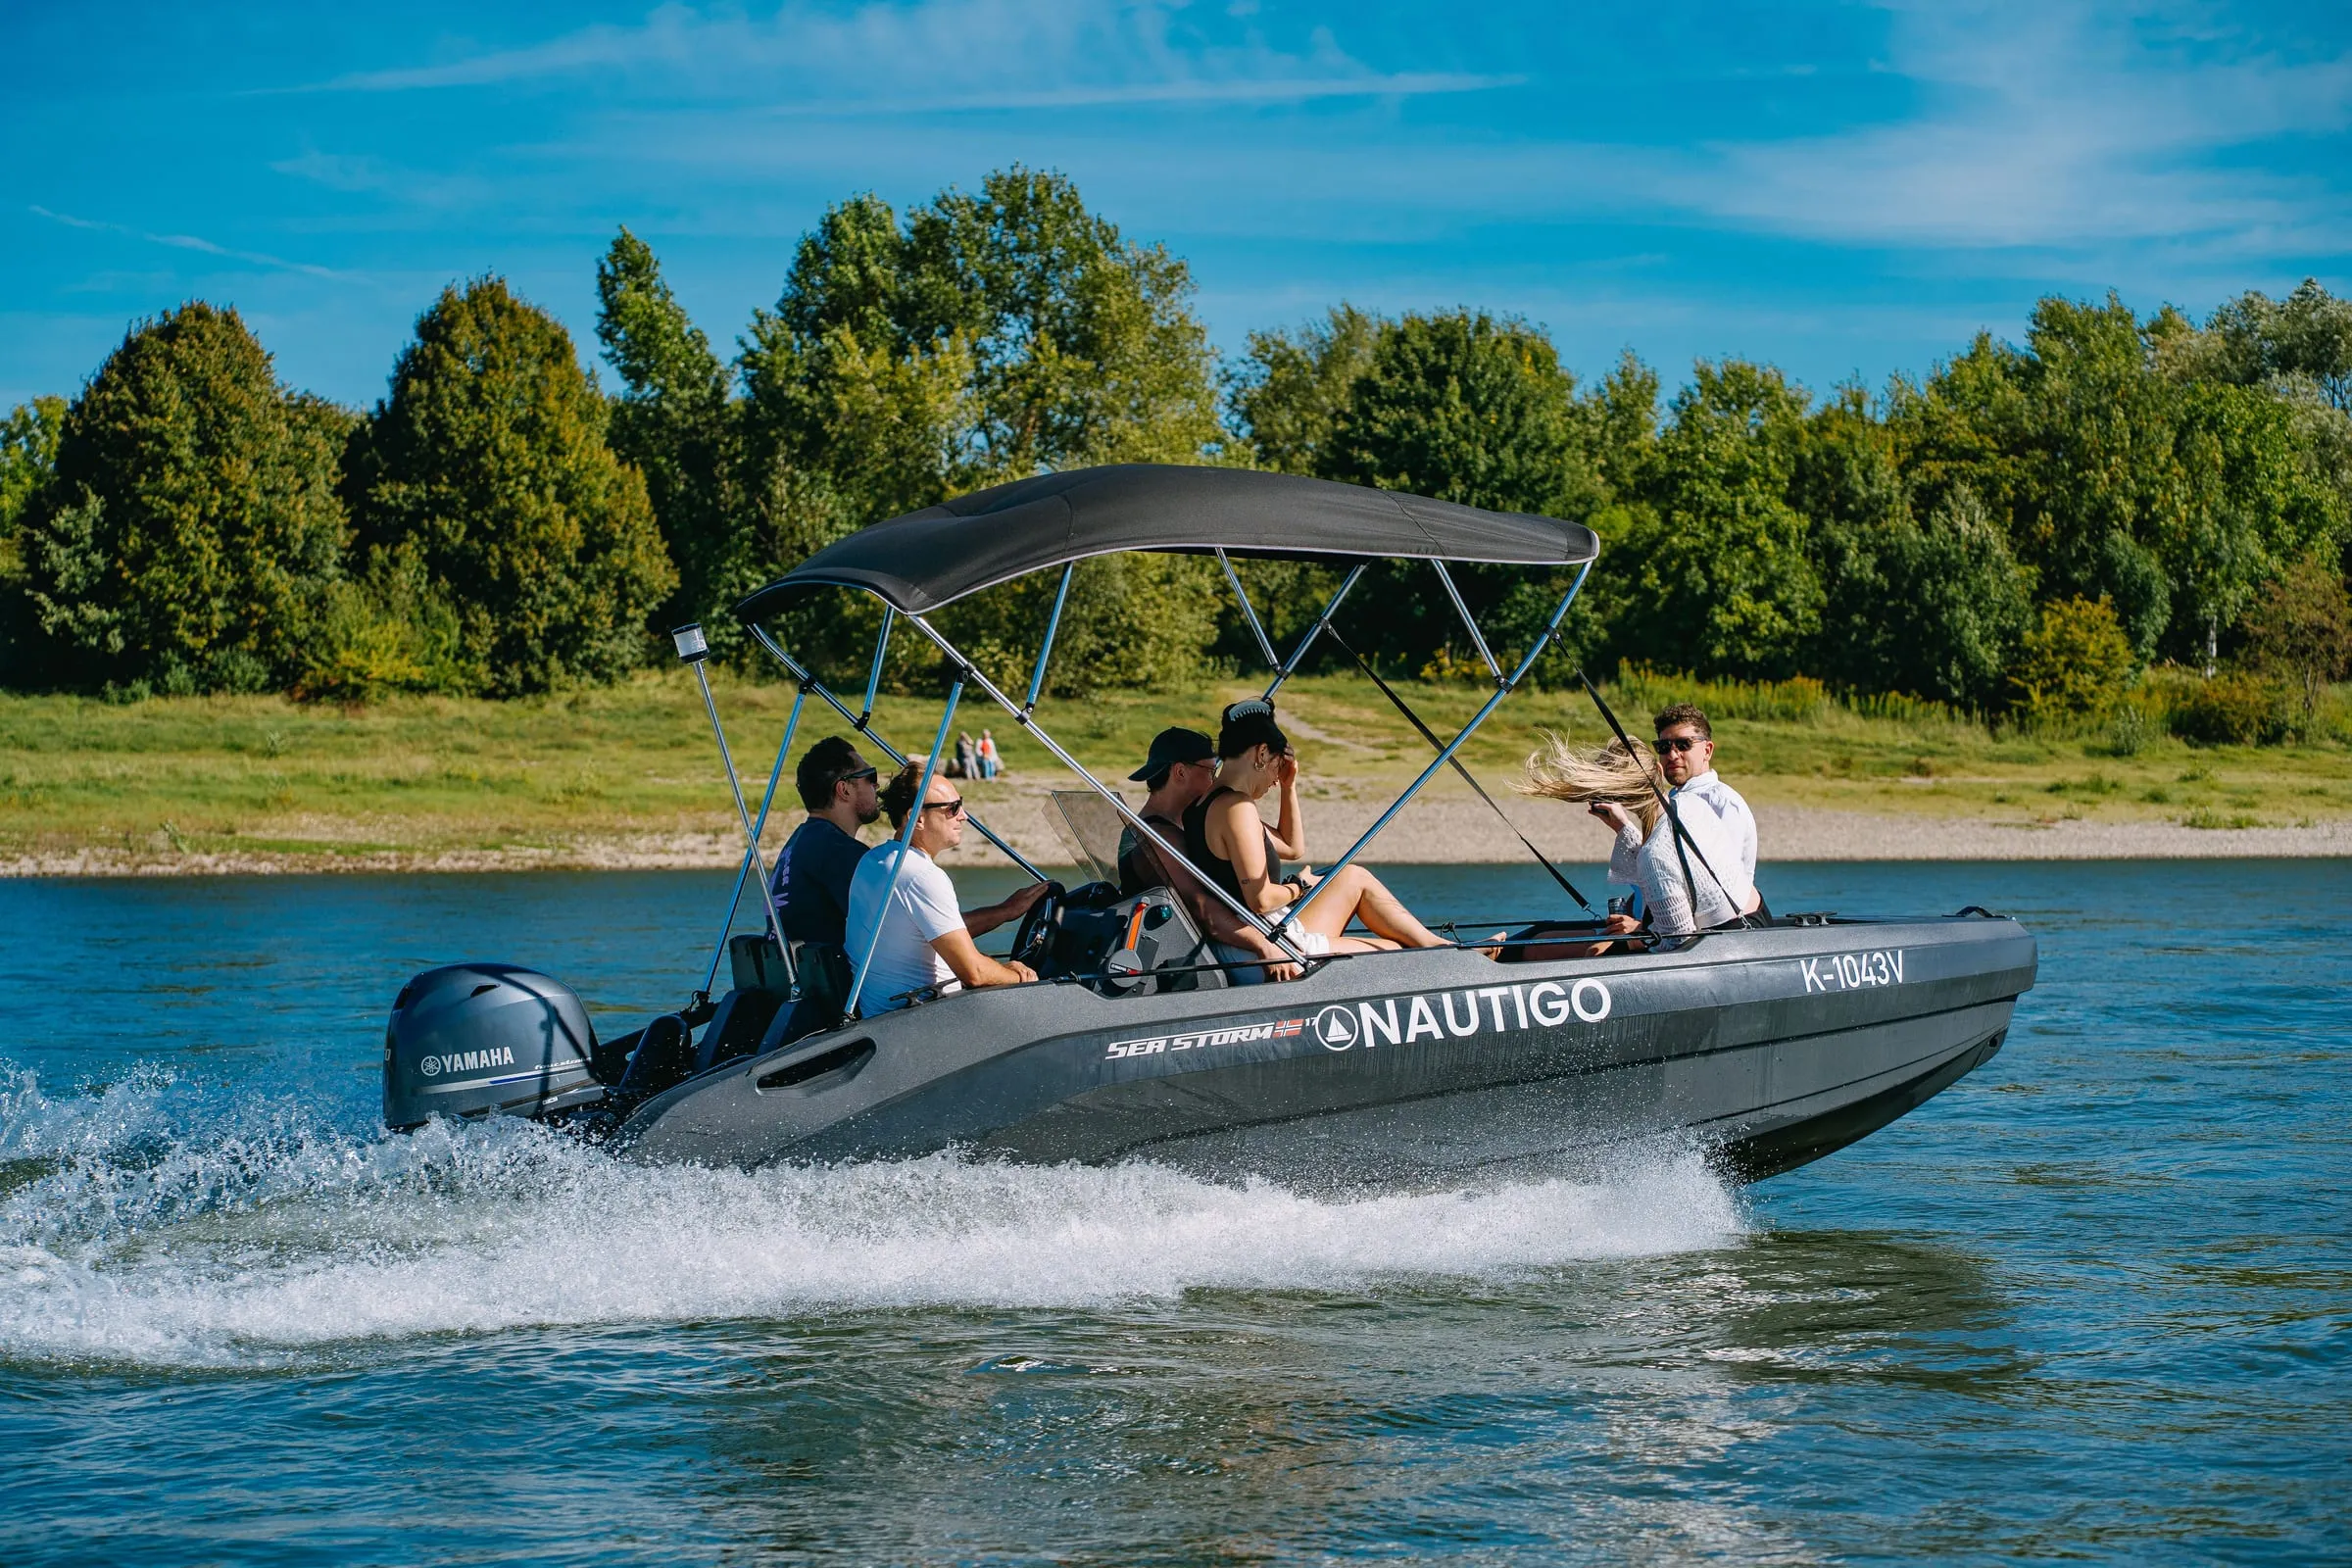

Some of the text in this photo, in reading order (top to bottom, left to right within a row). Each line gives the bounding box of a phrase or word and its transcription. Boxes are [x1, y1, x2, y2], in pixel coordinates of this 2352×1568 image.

[1800, 950, 1902, 993] K-1043V
[1358, 978, 1612, 1048] NAUTIGO
[441, 1046, 514, 1073] YAMAHA
[1104, 1039, 1167, 1060] SEA
[1170, 1023, 1274, 1052] STORM
